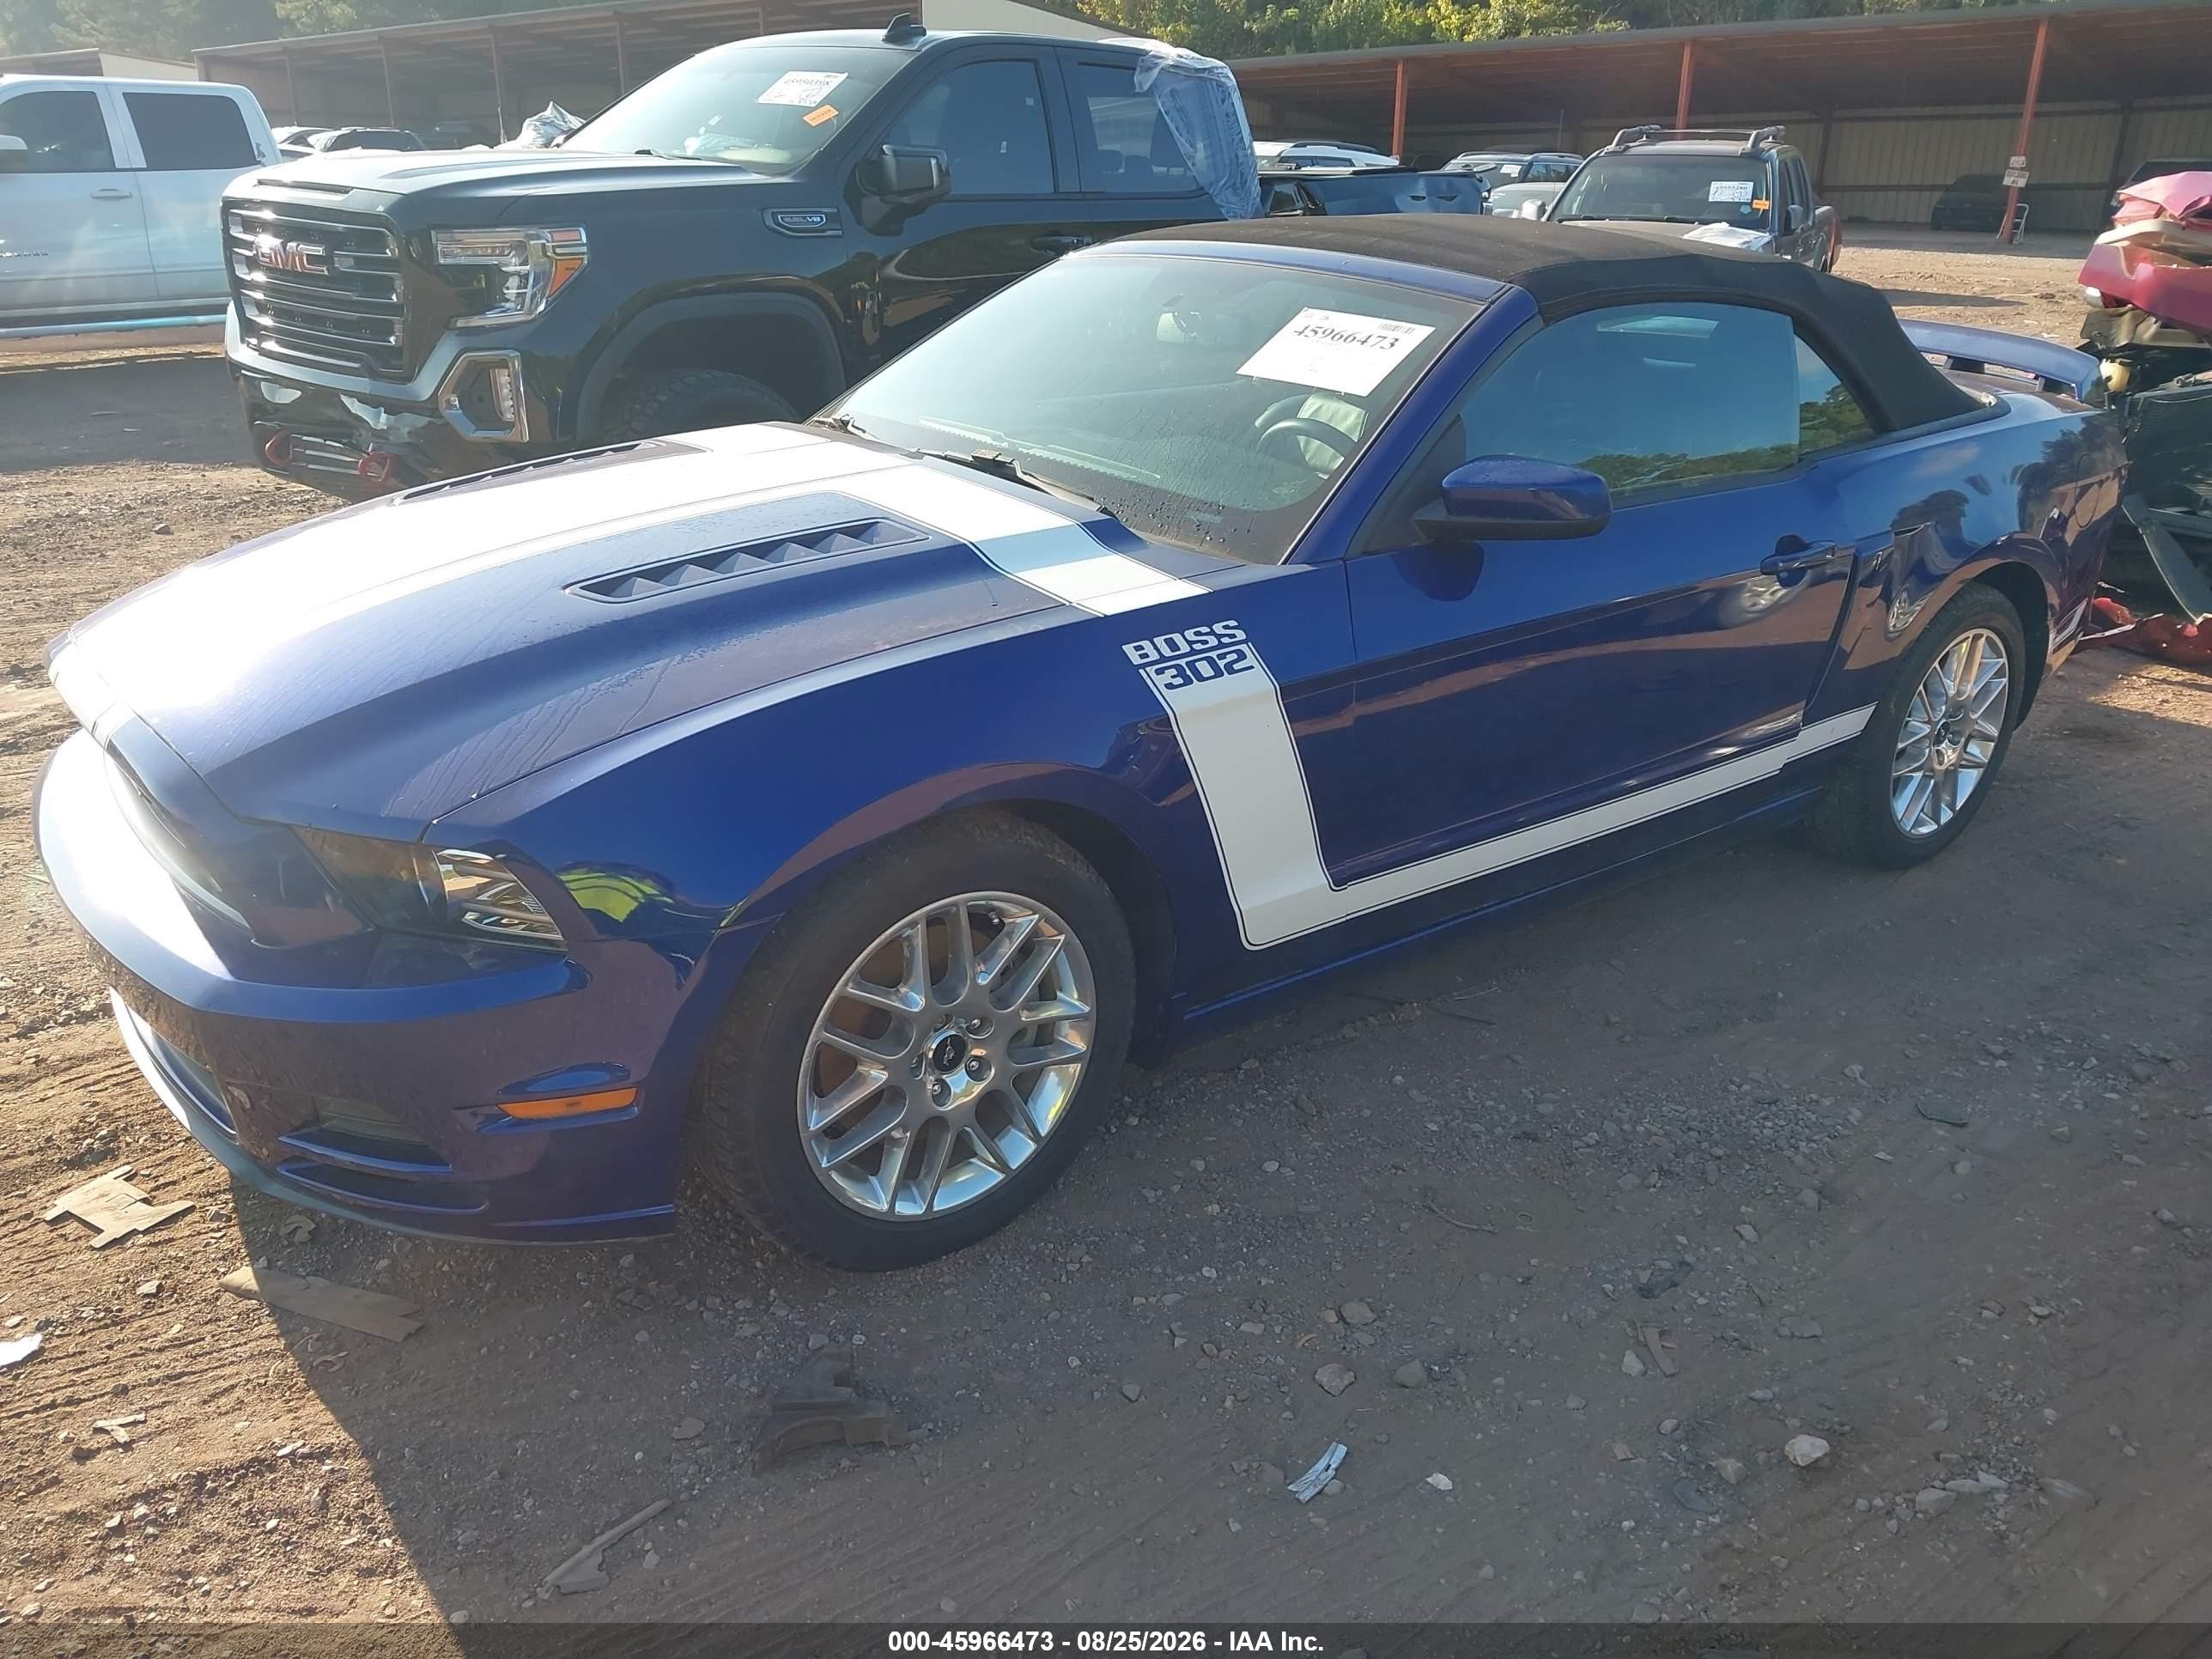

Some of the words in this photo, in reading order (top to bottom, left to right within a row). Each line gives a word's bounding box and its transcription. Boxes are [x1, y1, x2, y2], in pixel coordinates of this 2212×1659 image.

[255, 234, 329, 275] GMC
[1293, 324, 1401, 351] 45966473
[1121, 619, 1247, 665] BOSS
[1153, 648, 1256, 690] 302
